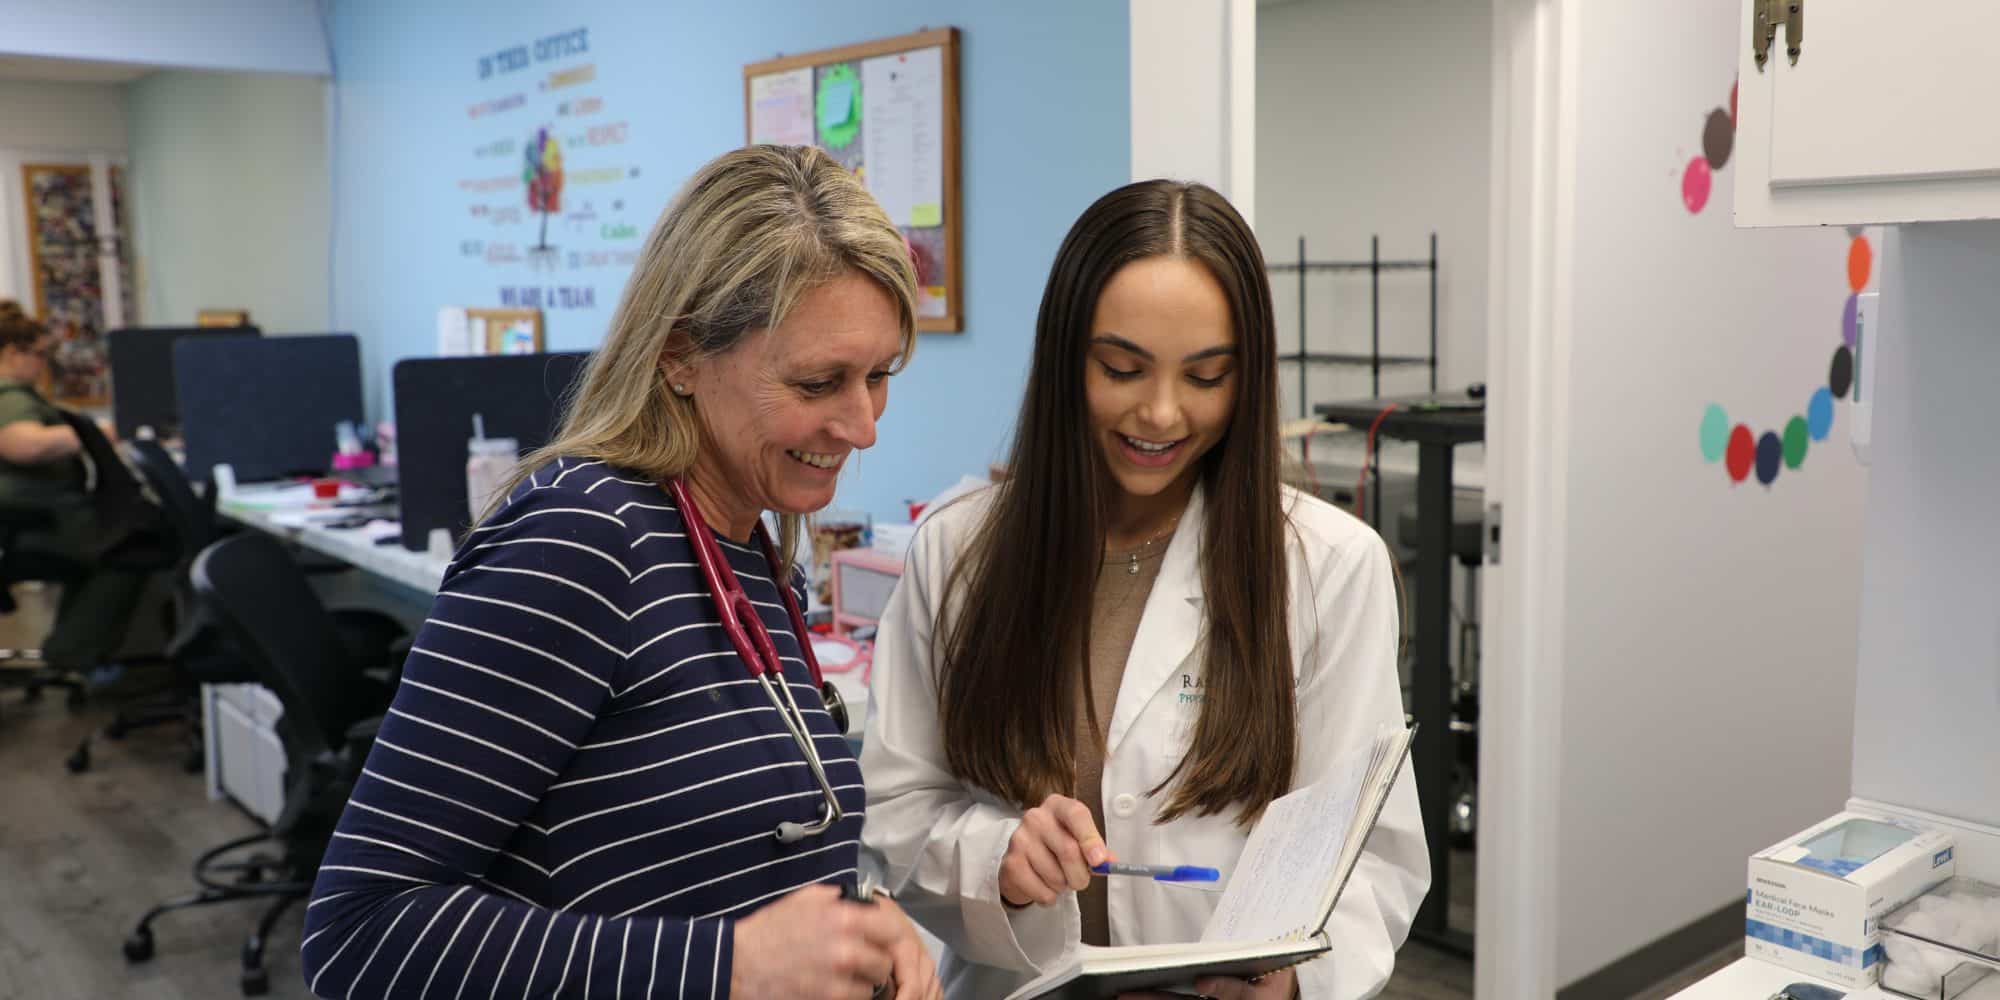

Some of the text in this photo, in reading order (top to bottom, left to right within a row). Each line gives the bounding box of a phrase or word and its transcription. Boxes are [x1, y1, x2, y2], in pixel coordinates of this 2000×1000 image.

[534, 27, 588, 61] OFFICE
[1755, 889, 1787, 905] Medical
[1809, 902, 1836, 919] Masks
